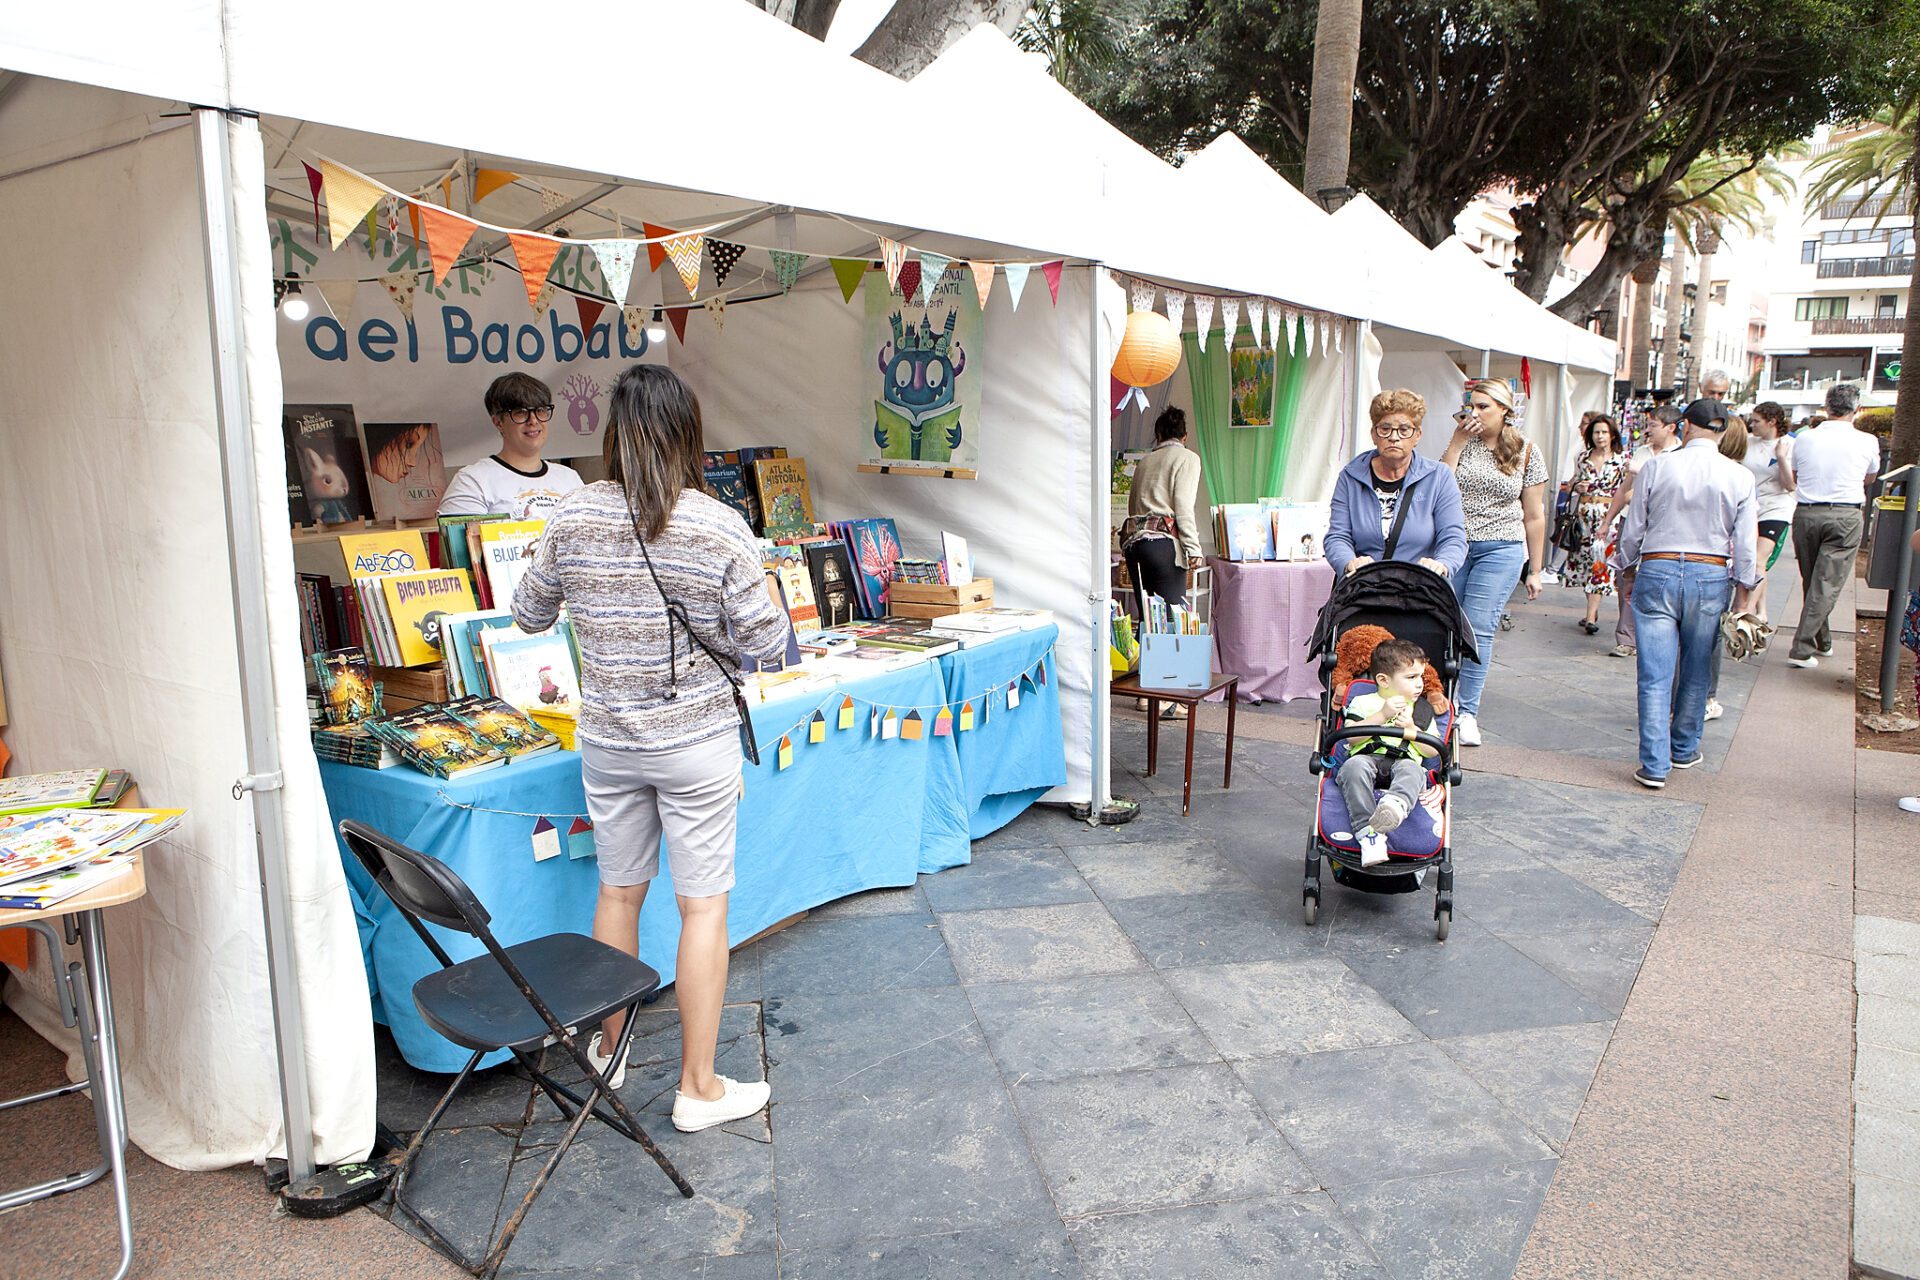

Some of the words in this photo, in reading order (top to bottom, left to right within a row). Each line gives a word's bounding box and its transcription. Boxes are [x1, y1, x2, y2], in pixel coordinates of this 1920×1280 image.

[931, 283, 961, 295] FANTIL
[441, 306, 649, 364] Baobab
[296, 419, 334, 435] INSTANTE
[769, 464, 792, 475] ATLAS
[766, 473, 802, 485] HISTORIA
[407, 489, 437, 498] ALICIA
[354, 552, 415, 573] ABEZOO
[493, 546, 521, 563] BLUE
[396, 580, 427, 605] BICHO
[428, 576, 463, 597] PELOTA
